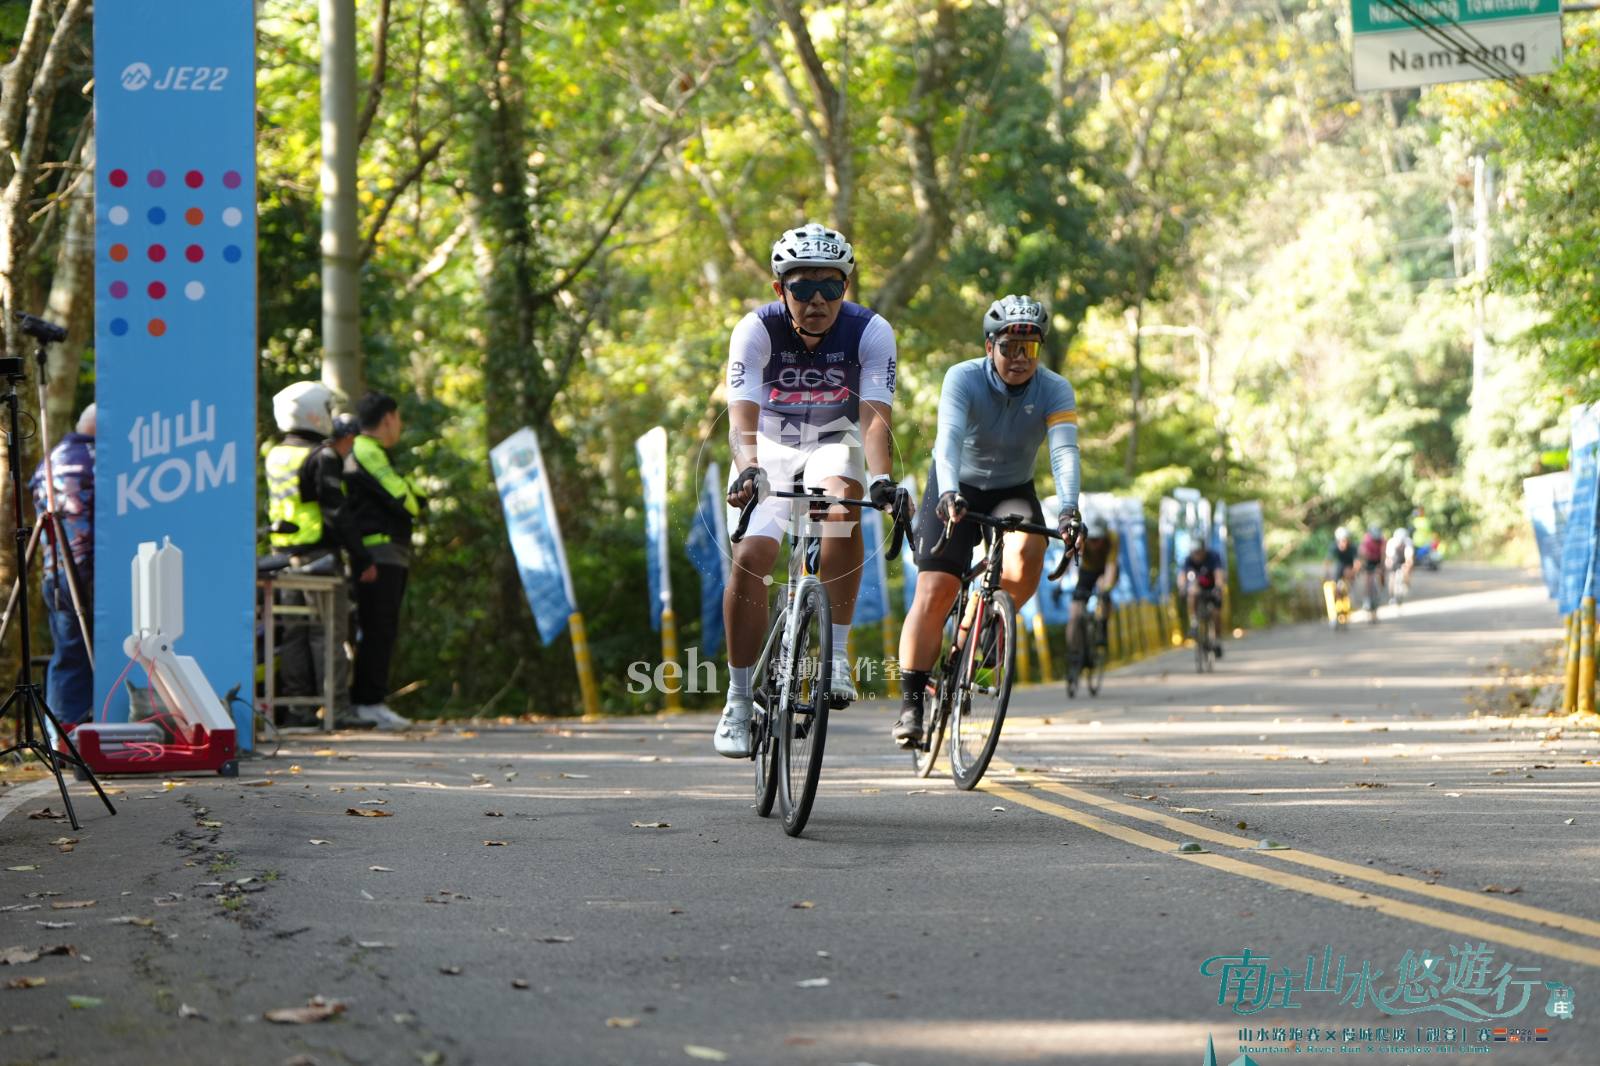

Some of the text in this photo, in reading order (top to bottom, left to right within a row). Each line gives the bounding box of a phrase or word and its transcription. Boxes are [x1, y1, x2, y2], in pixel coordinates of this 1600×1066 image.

[1389, 42, 1526, 72] Namzong
[153, 67, 229, 91] JE22
[801, 241, 839, 254] 2128
[127, 399, 216, 463] 仙山
[116, 442, 236, 516] KOM
